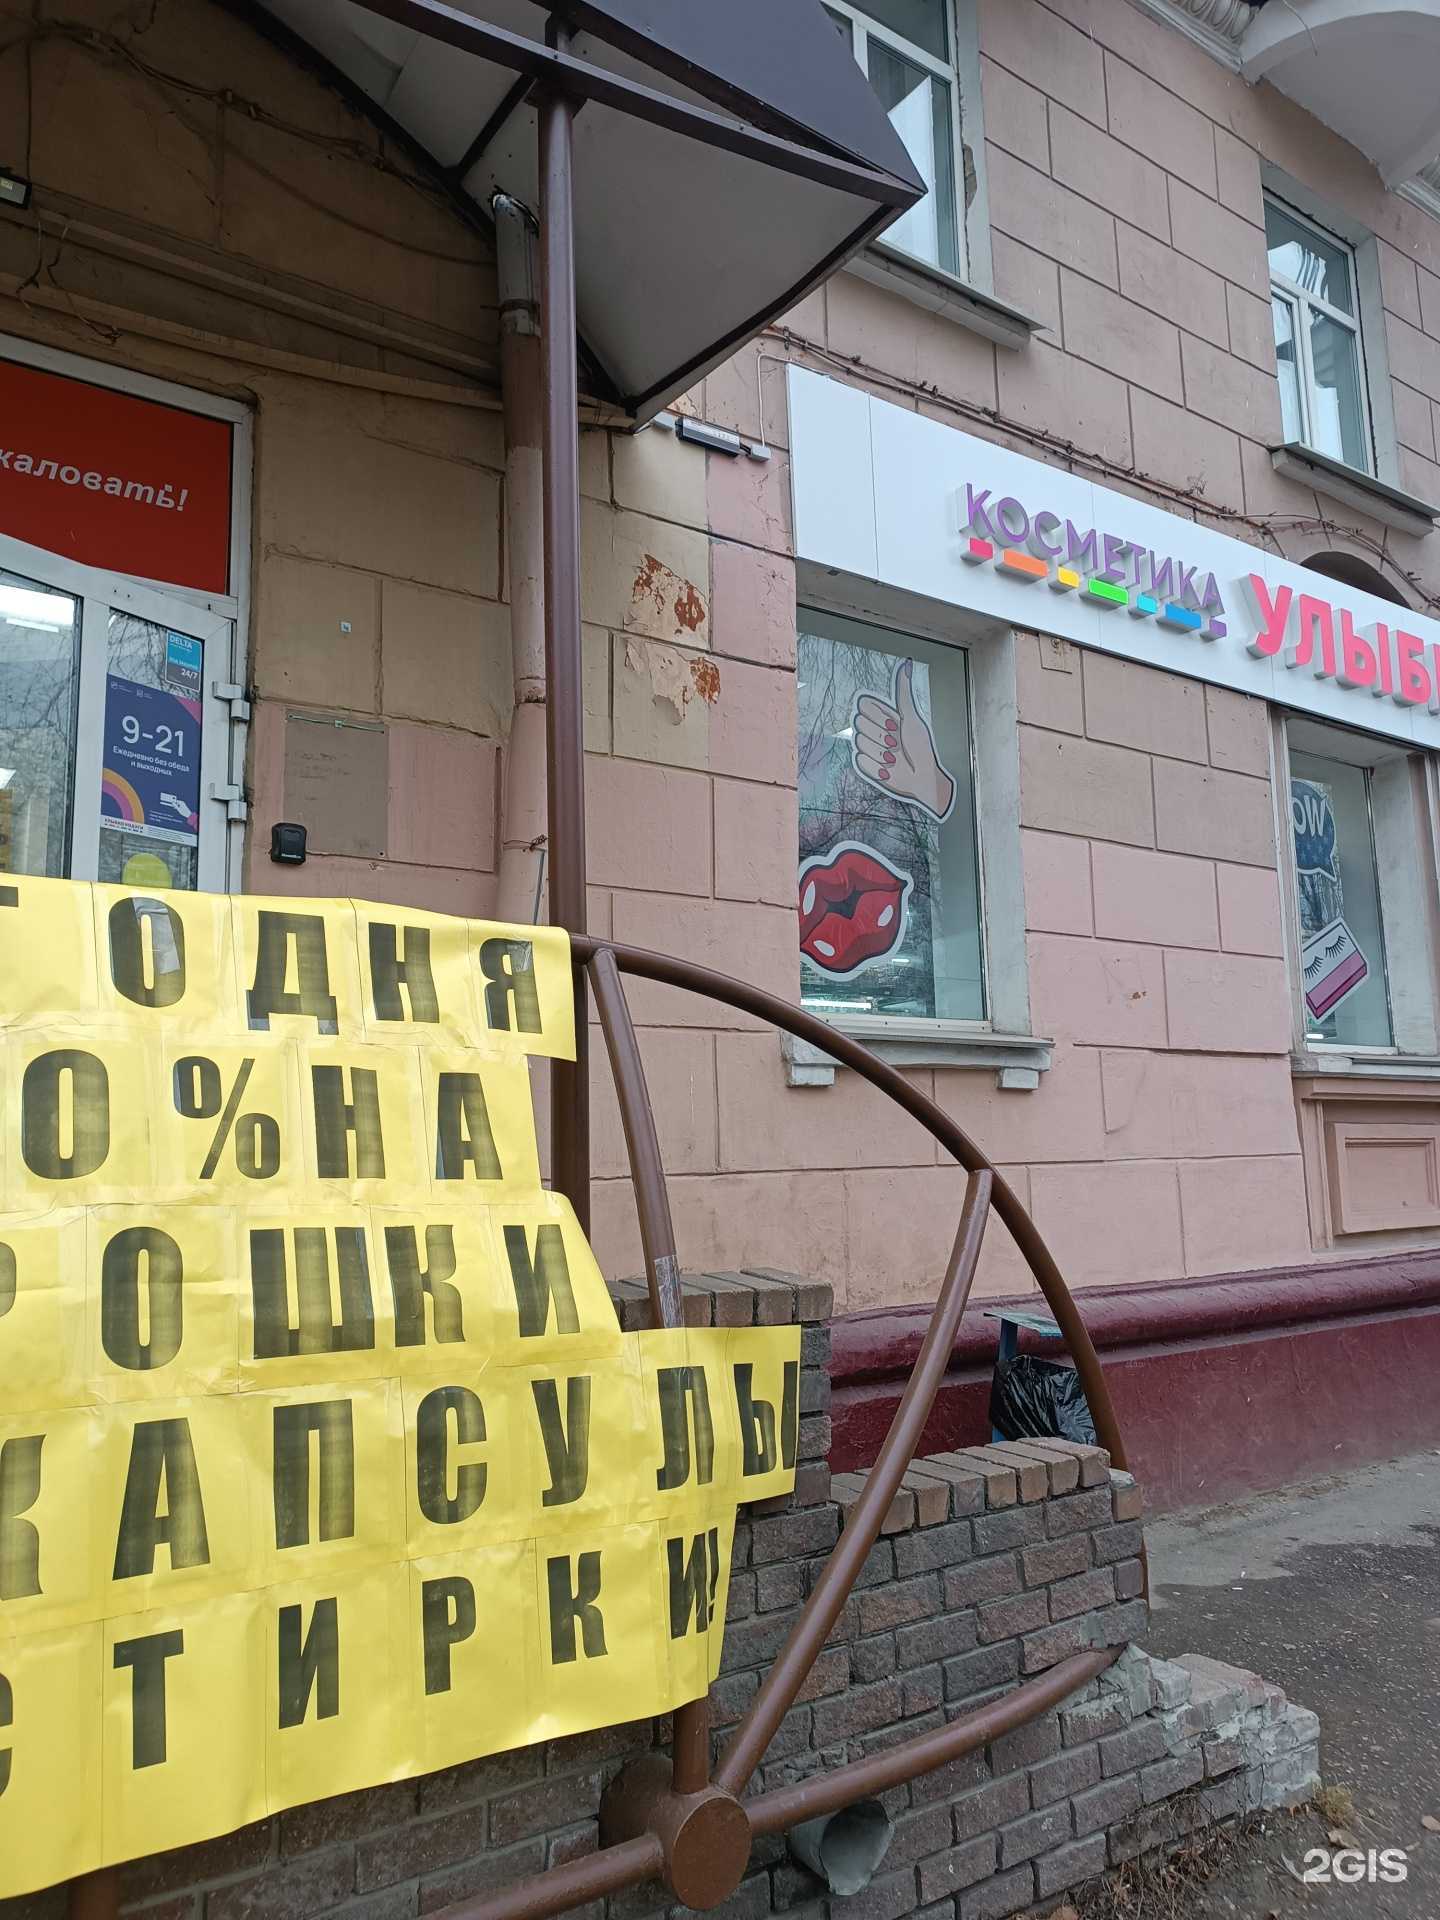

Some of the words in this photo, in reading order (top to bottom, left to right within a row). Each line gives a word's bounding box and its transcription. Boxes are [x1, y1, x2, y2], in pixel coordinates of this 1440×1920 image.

[959, 483, 1224, 616] КОСМЕТИКА
[1247, 573, 1440, 716] УЛЫБ
[112, 745, 154, 763] Ежедневно
[122, 715, 183, 757] 9-21
[0, 885, 543, 1034] ОДНЯ
[0, 1526, 720, 1797] ТИРКИ!
